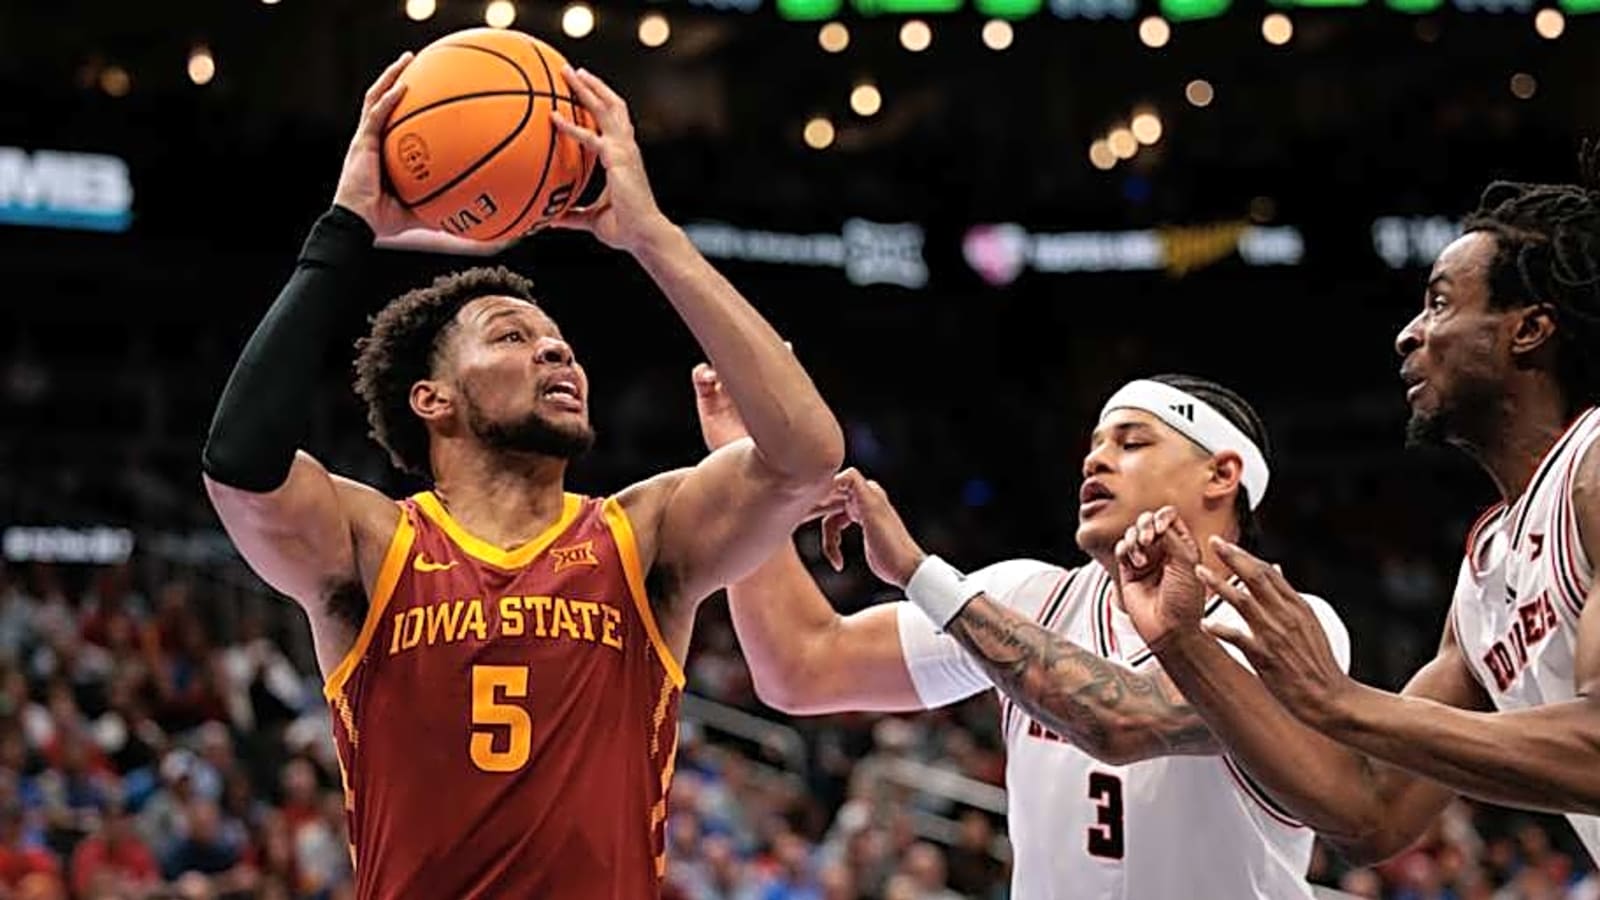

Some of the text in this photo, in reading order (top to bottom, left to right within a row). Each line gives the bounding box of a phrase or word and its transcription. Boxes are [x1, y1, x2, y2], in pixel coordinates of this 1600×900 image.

[389, 596, 624, 655] IOWA STATE
[470, 665, 532, 772] 5
[1087, 771, 1125, 861] 3
